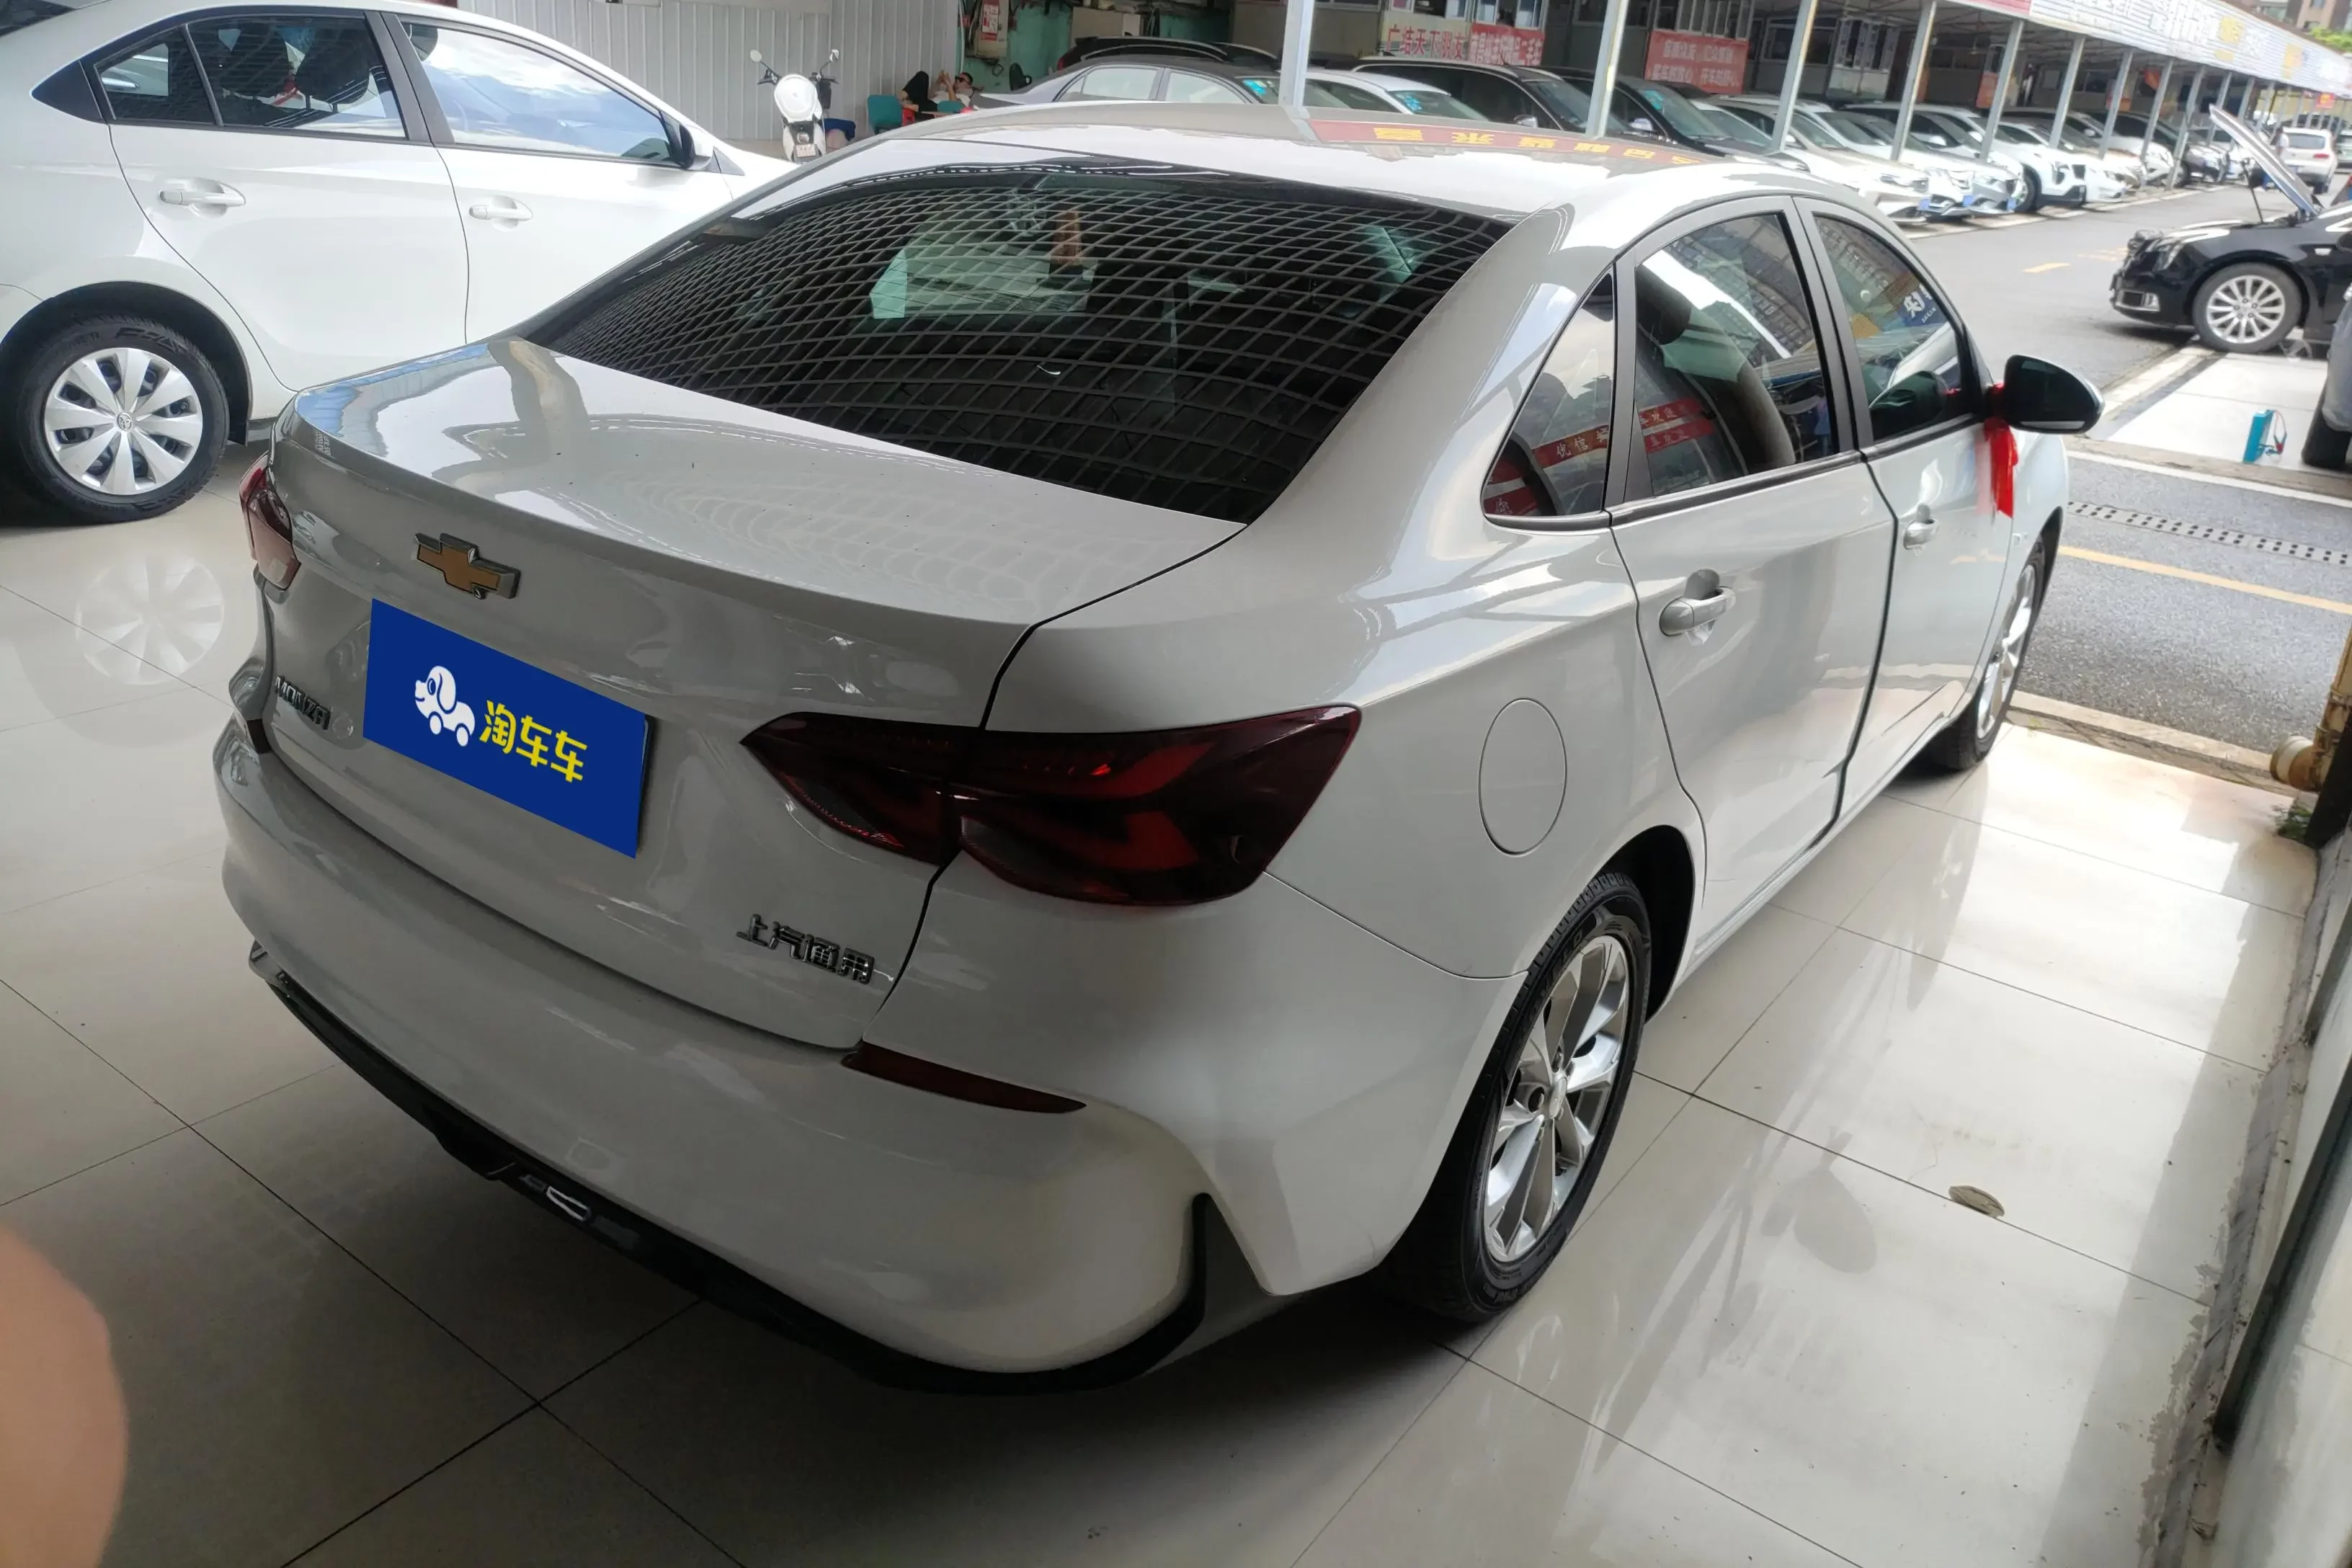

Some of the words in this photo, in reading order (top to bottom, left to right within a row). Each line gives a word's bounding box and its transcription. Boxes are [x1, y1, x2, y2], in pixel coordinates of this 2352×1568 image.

[275, 674, 331, 731] MONZA
[736, 914, 875, 984] 上汽通用
